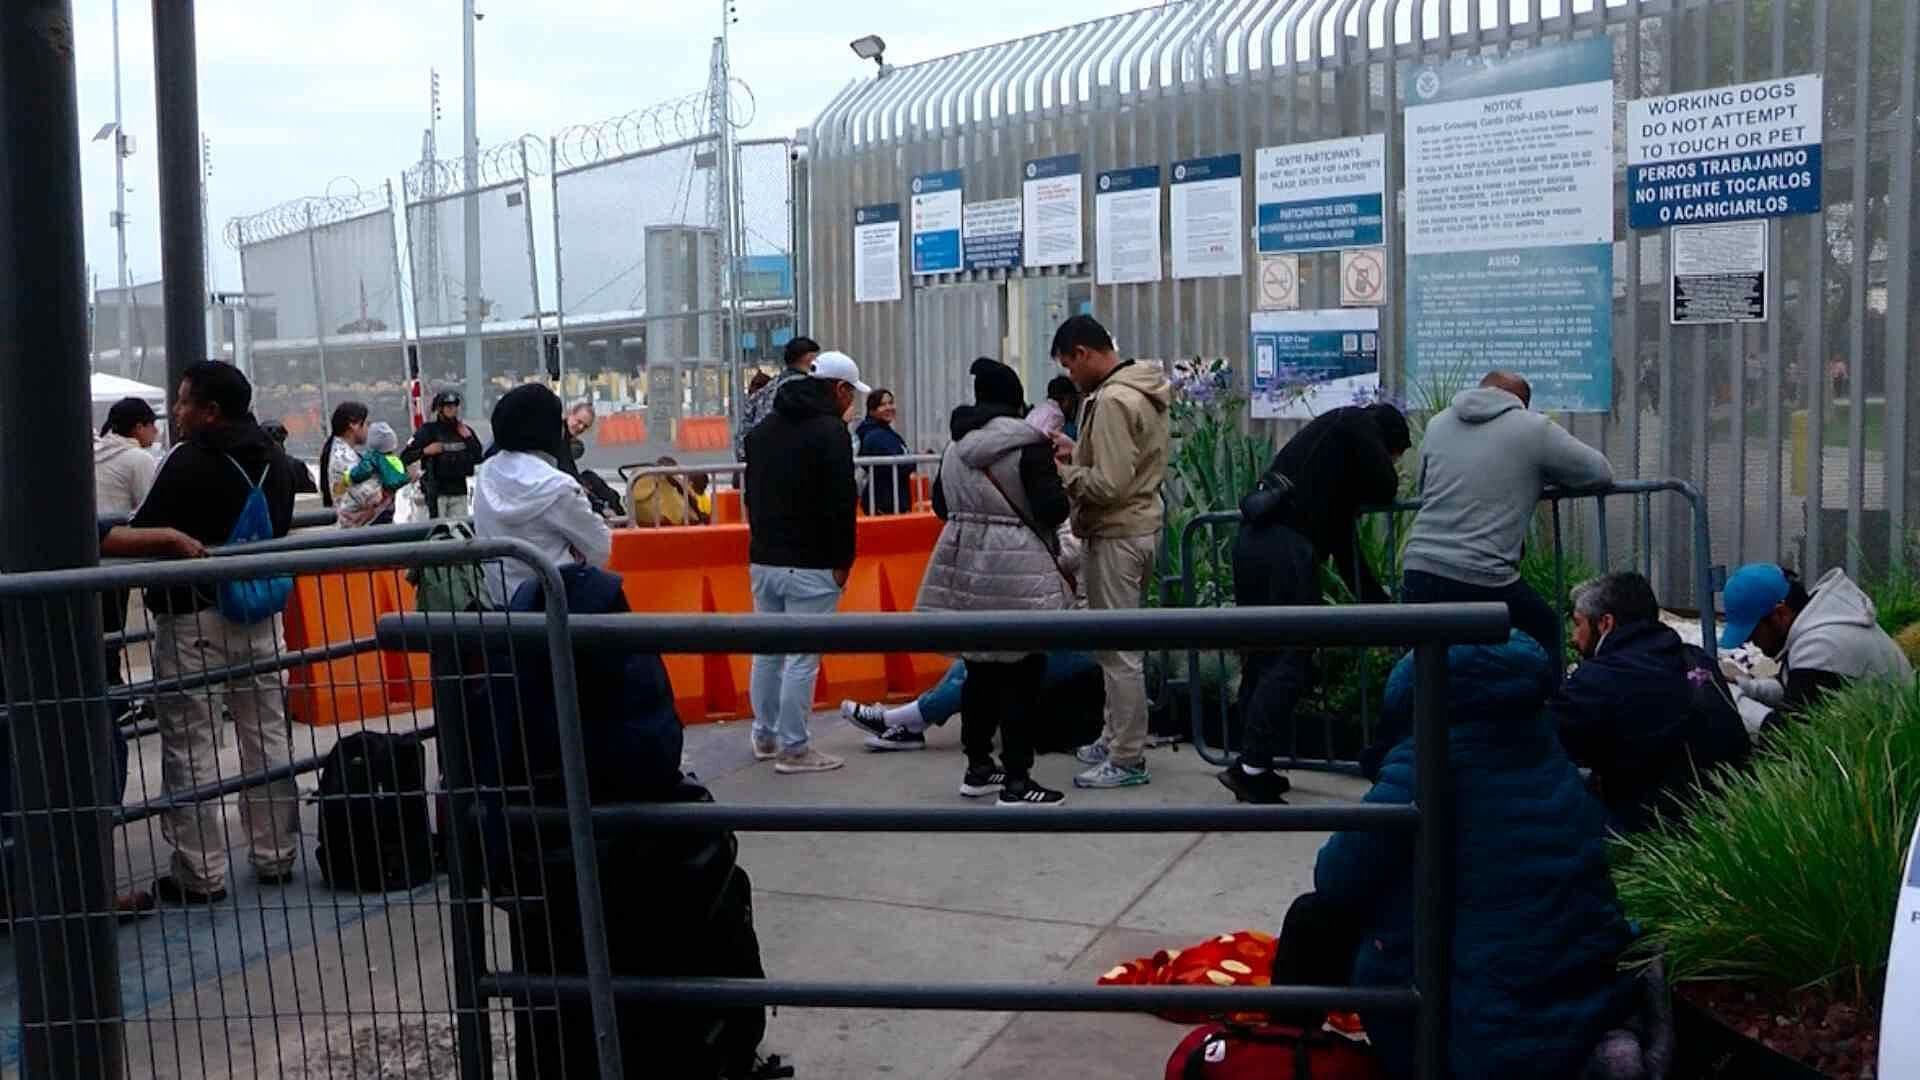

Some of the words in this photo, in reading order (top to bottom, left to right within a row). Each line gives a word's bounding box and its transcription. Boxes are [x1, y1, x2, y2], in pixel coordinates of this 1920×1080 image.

[1483, 99, 1522, 113] NOTICE
[1648, 92, 1734, 116] WORKING
[1740, 82, 1796, 104] DOGS
[1642, 122, 1667, 138] DO
[1672, 116, 1708, 134] NOT
[1712, 104, 1798, 129] ATTEMPT
[1304, 149, 1360, 164] PARTICIPANTS
[1641, 144, 1662, 160] TO
[1669, 136, 1729, 155] TOUCH
[1735, 132, 1762, 148] OR
[1769, 126, 1806, 144] PET
[1639, 162, 1697, 182] PERROS
[1701, 150, 1807, 176] TRABAJANDO
[1635, 187, 1655, 204] NO
[1659, 180, 1721, 200] INTENTE
[1726, 171, 1812, 194] TOCARLOS
[1660, 206, 1670, 222] O
[1674, 196, 1789, 221] ACARICIARLOS
[1488, 254, 1520, 266] AVISO
